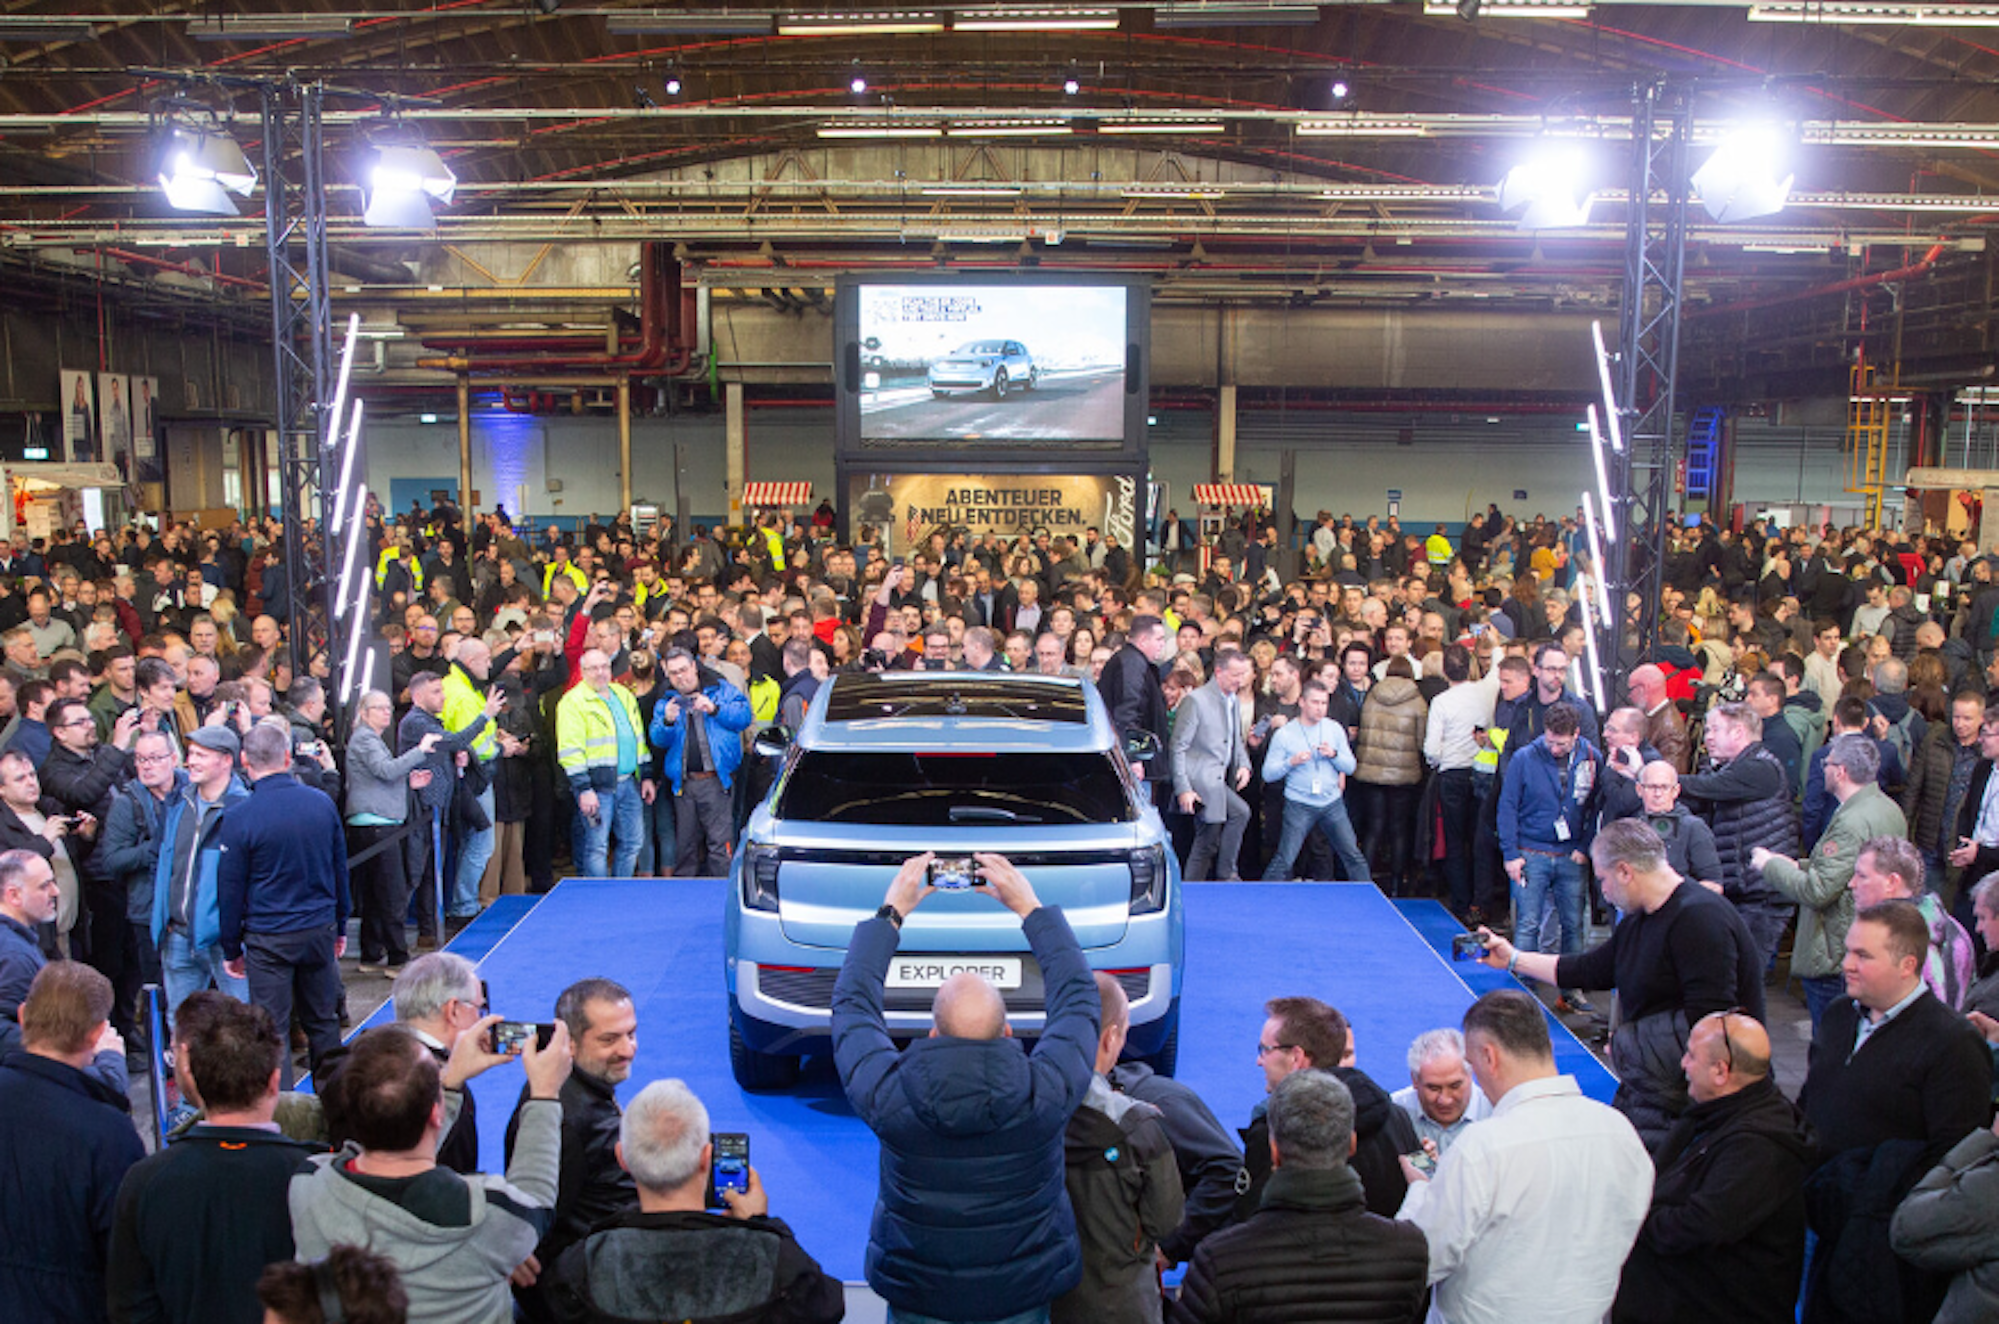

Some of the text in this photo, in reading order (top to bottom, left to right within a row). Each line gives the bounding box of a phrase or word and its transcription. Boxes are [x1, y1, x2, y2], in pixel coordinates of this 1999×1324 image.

[945, 489, 1063, 506] ABENTEUER
[921, 508, 1087, 525] NEU ENTDECKEN.
[1104, 474, 1136, 549] Ford
